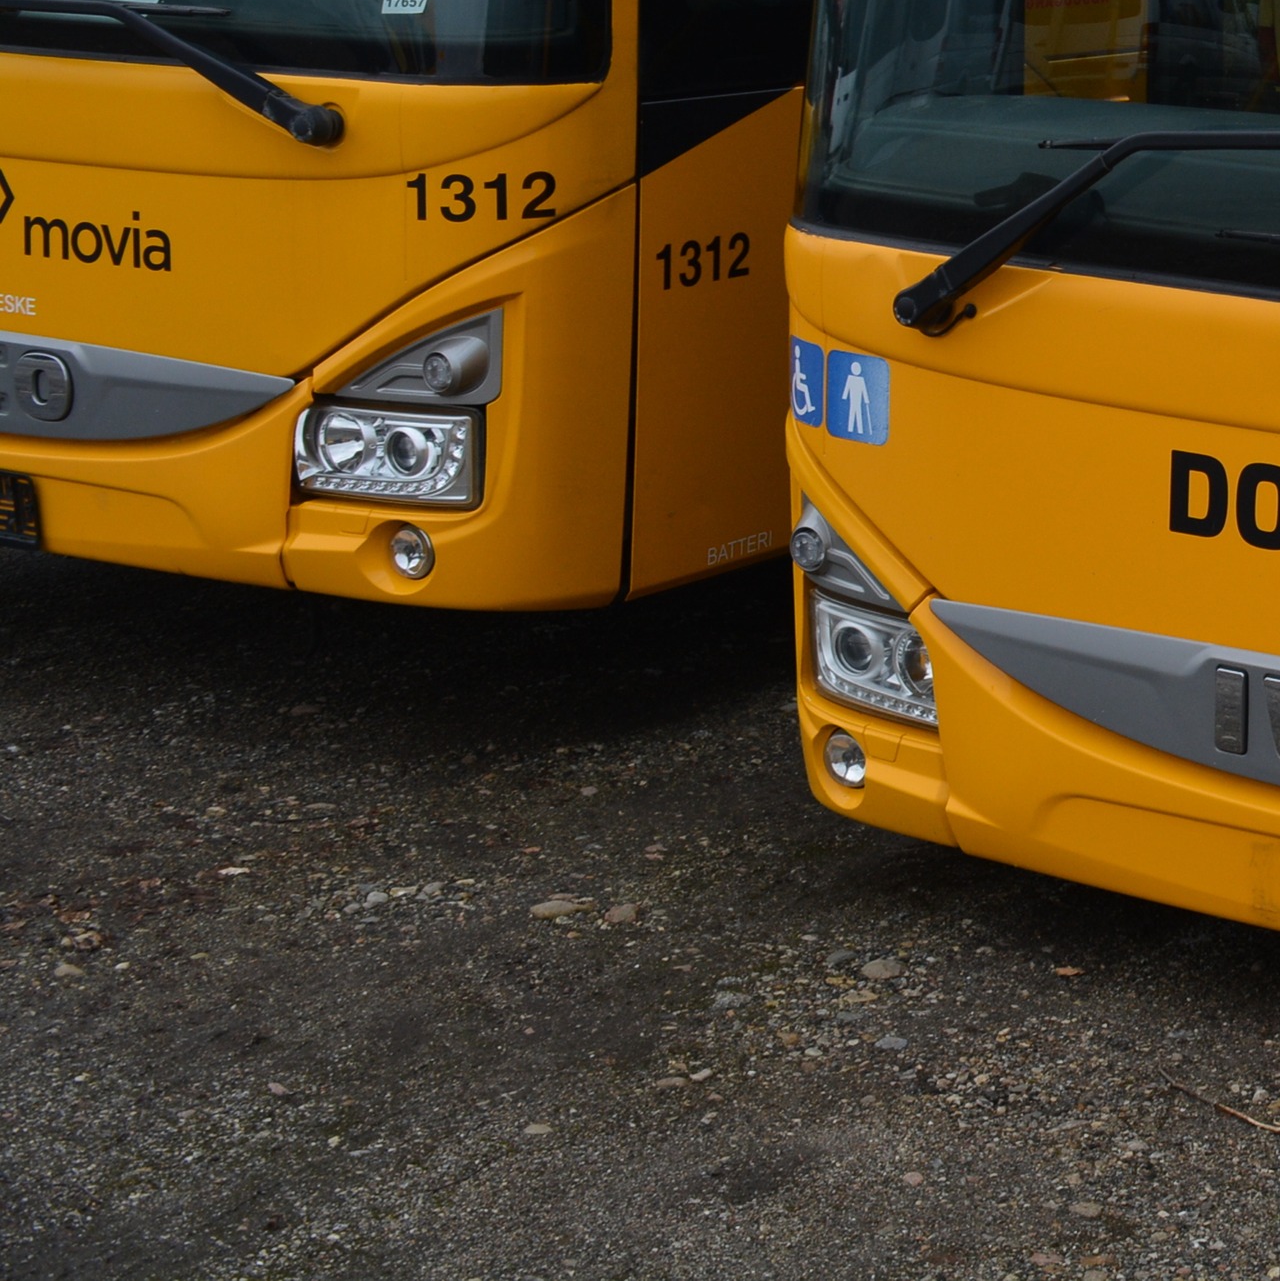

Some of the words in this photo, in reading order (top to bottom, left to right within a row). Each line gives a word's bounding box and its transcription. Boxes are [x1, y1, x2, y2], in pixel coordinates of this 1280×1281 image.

[405, 170, 557, 223] 1312
[23, 210, 172, 272] movia
[655, 231, 751, 291] 1312
[707, 529, 773, 566] BATTERI
